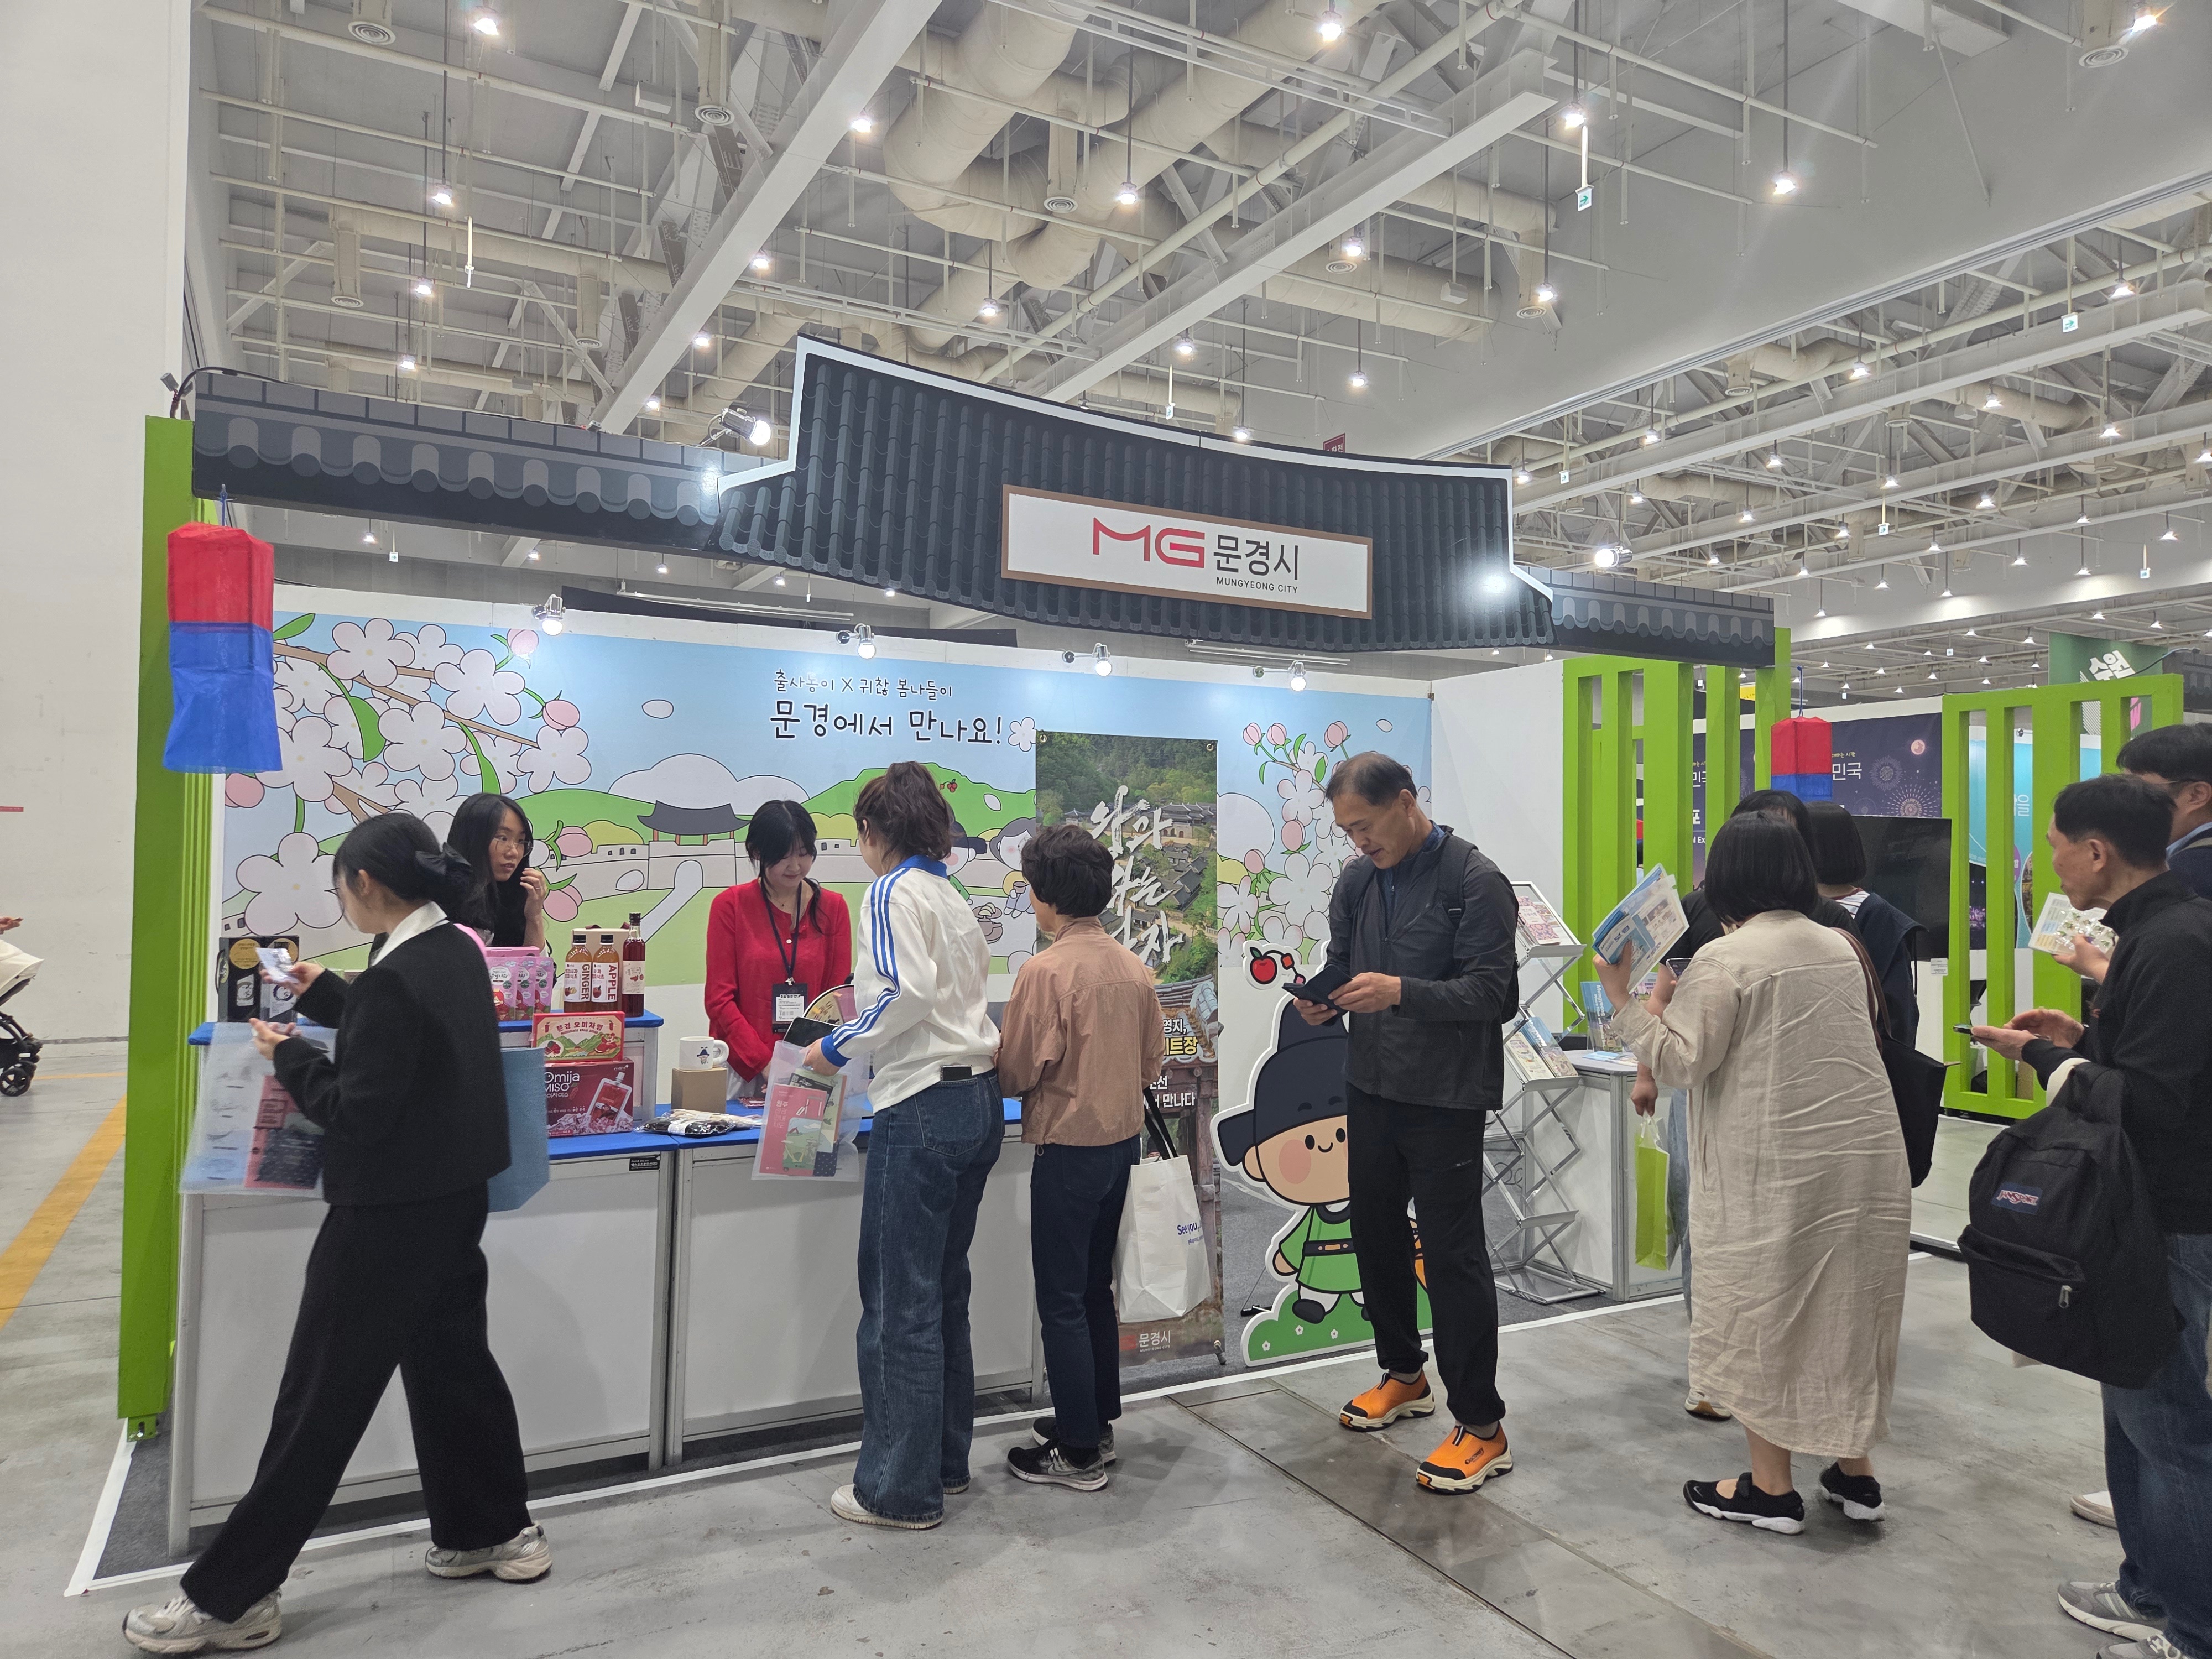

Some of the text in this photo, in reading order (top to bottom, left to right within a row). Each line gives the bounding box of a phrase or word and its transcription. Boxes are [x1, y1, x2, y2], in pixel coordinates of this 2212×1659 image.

[1092, 517, 1206, 568] MG
[1213, 534, 1299, 581] 문경시
[1217, 577, 1298, 594] MUNGYEONG CITY
[842, 678, 853, 692] X
[896, 679, 952, 701] 봄나들이
[770, 700, 1003, 745] 문경에서 만나요!
[1832, 762, 1863, 781] 민국
[581, 964, 590, 1000] GINGER
[607, 964, 617, 1000] APPLE
[1597, 985, 1605, 1016] Mungyeong
[1163, 1018, 1187, 1035] 영지,
[544, 1071, 580, 1084] Omija
[1162, 1092, 1196, 1108] 만나다
[1177, 1224, 1188, 1235] See
[1139, 1330, 1171, 1348] 문경시
